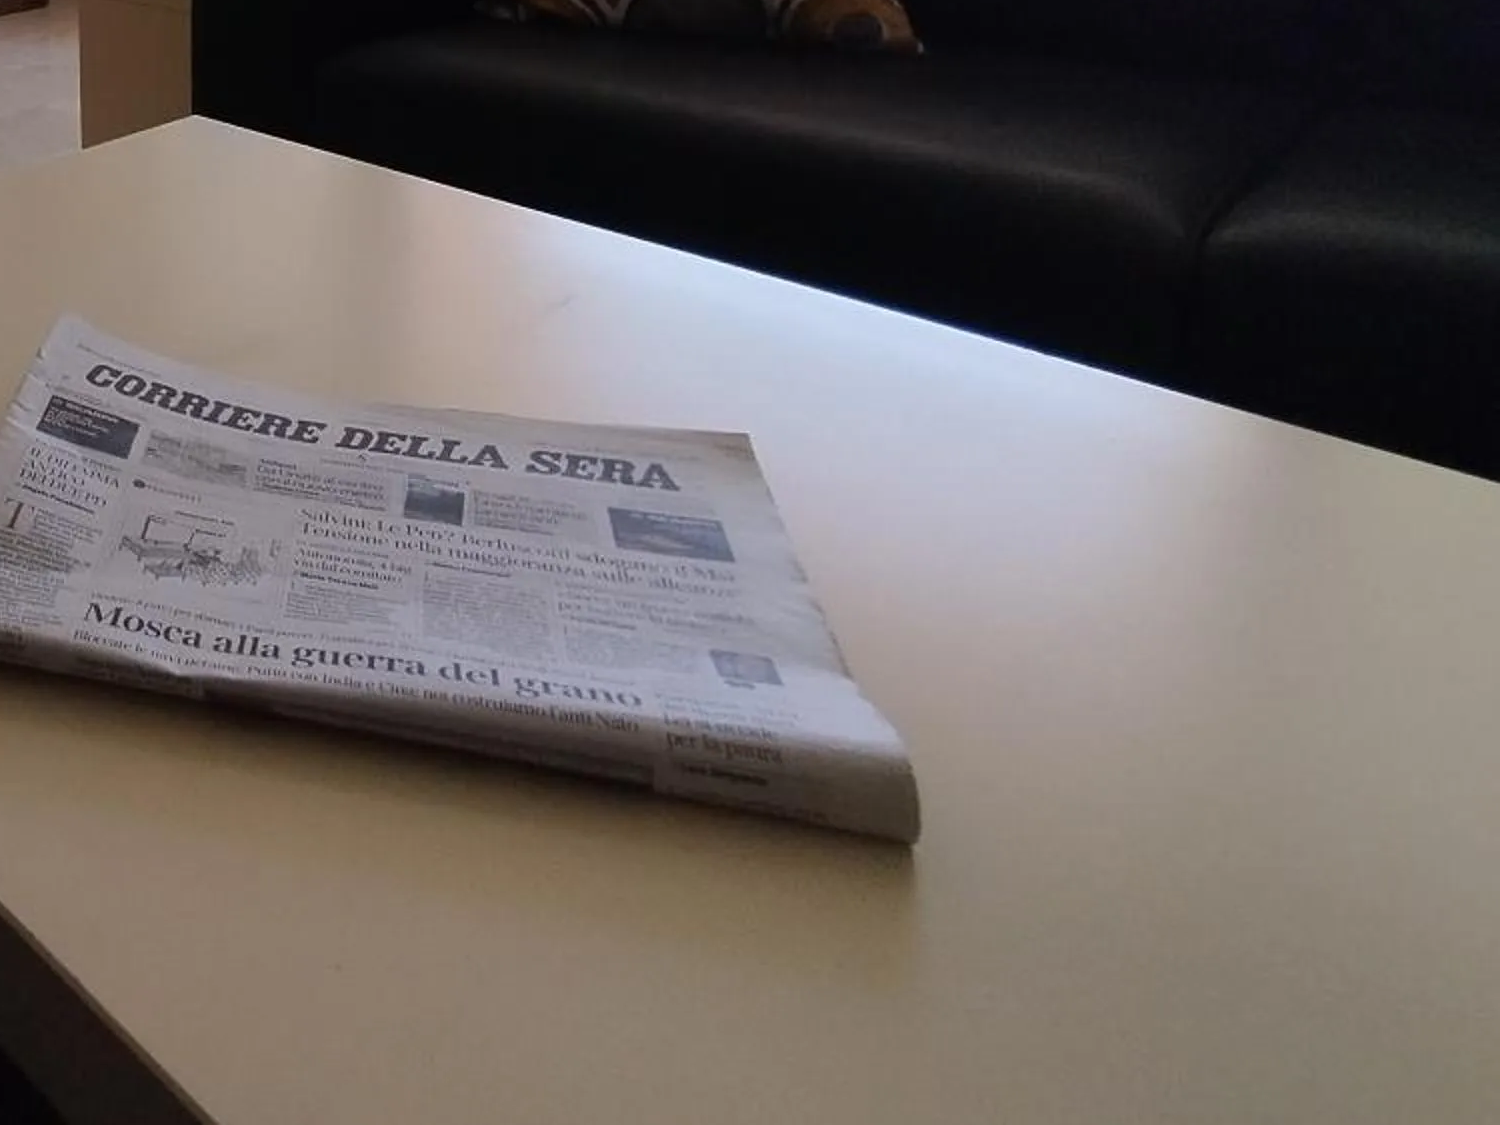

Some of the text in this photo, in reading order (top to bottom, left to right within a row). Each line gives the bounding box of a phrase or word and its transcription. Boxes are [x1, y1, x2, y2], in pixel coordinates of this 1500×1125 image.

[85, 363, 328, 445] CORRIERE
[335, 427, 509, 470] DELLA
[525, 449, 682, 492] SERA
[83, 601, 643, 707] Mosca alla guerra del grano
